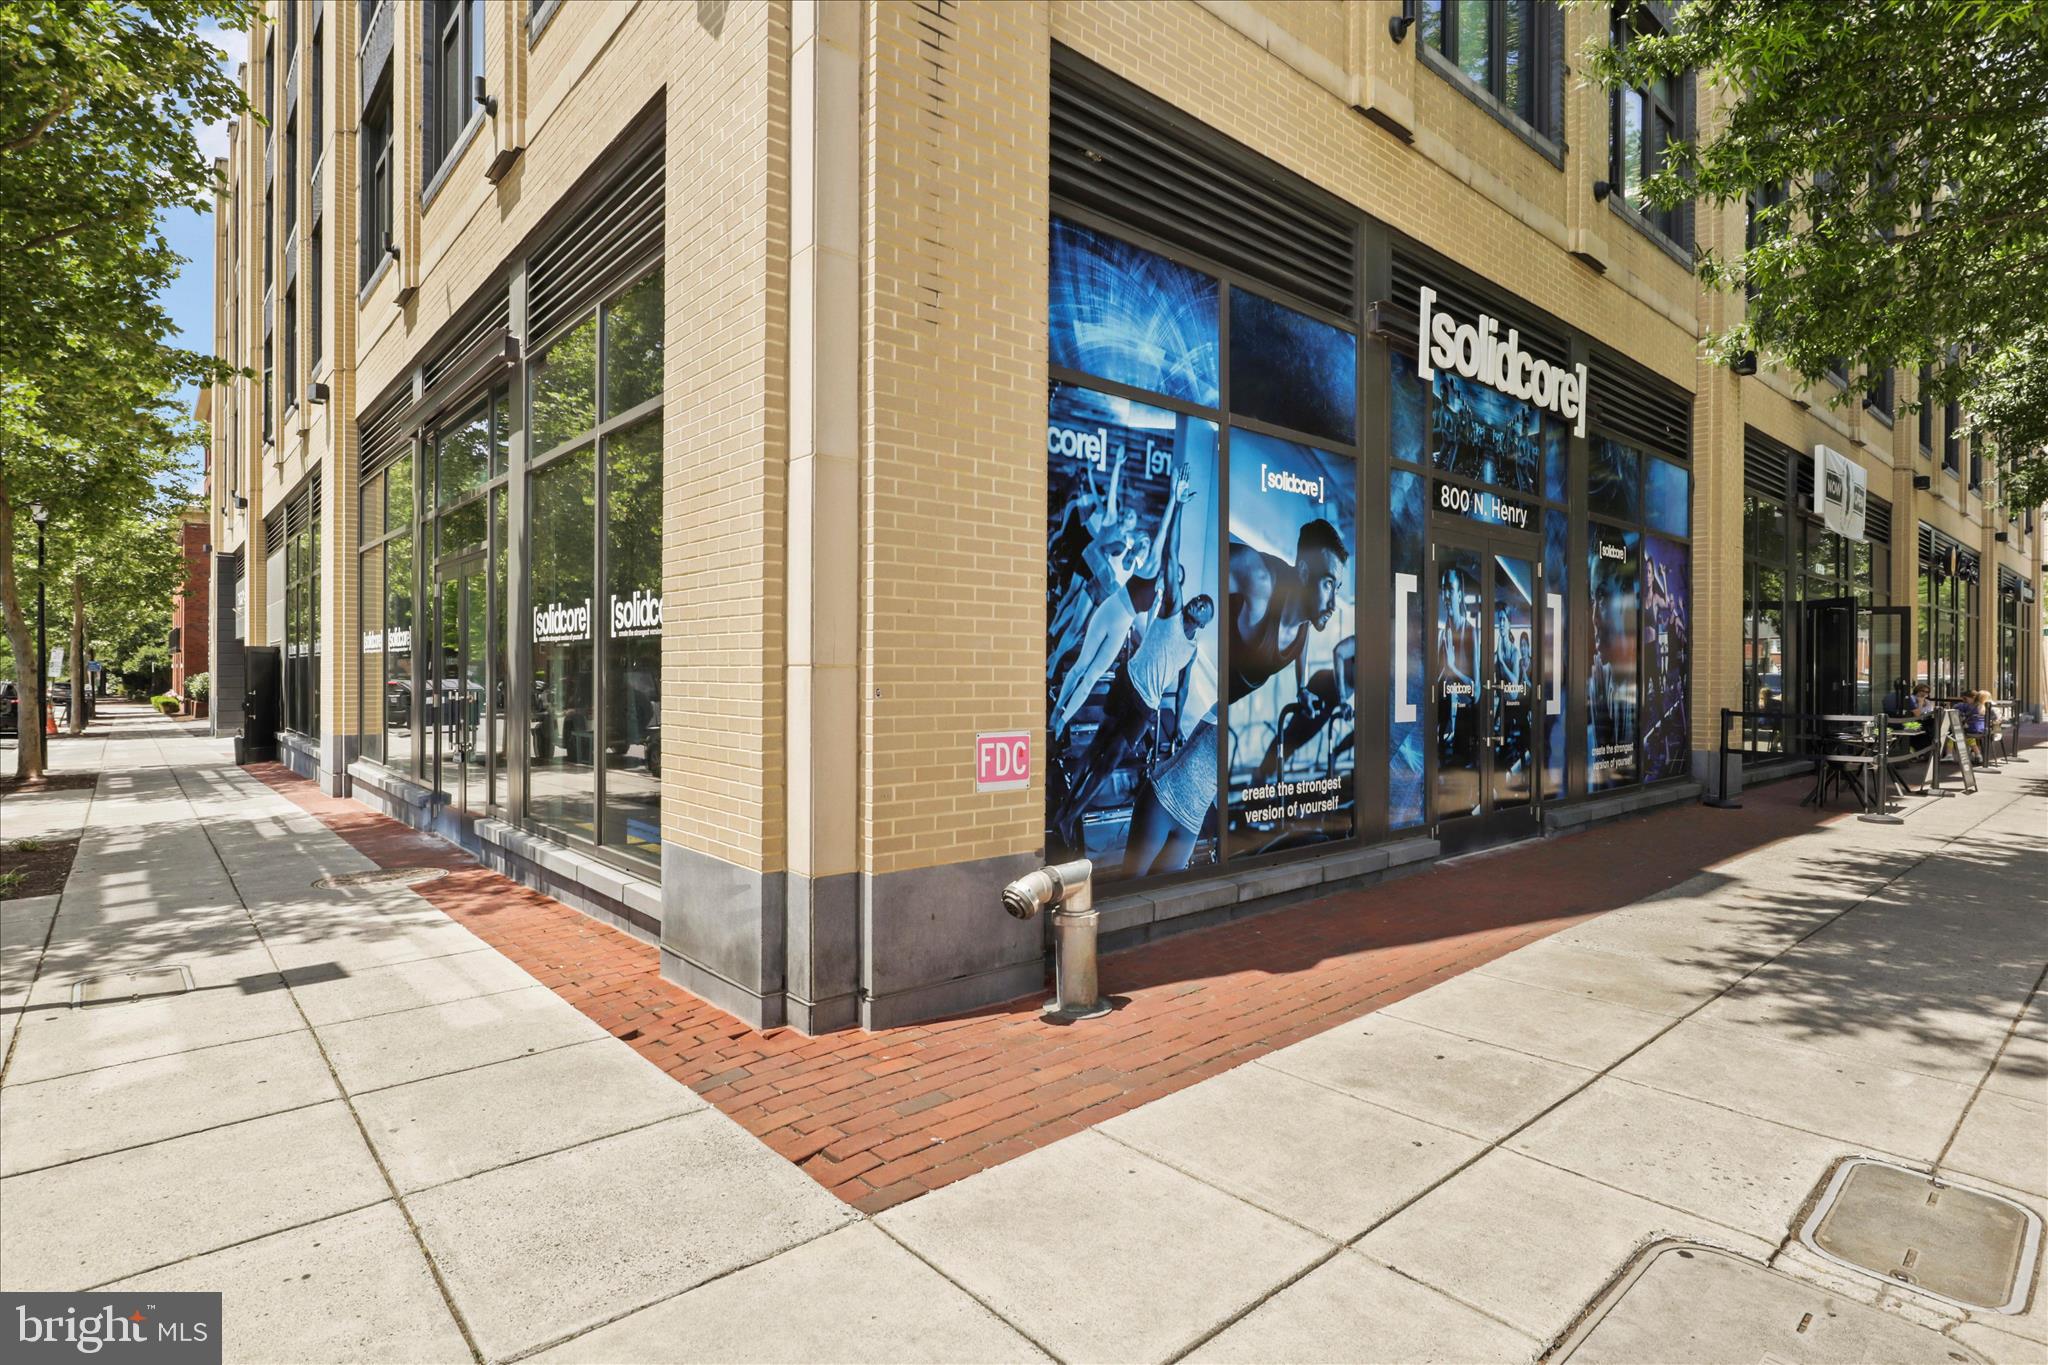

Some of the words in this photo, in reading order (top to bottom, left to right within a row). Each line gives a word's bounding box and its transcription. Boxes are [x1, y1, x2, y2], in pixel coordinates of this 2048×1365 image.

[1441, 485, 1470, 512] 800
[1474, 493, 1488, 516] N.
[1492, 497, 1527, 528] Henry
[981, 741, 1026, 777] FDC
[1242, 784, 1275, 801] create
[1277, 782, 1295, 796] the
[1296, 776, 1341, 794] strongest
[1245, 805, 1284, 823] version
[1287, 801, 1298, 817] of
[1300, 796, 1339, 818] yourself
